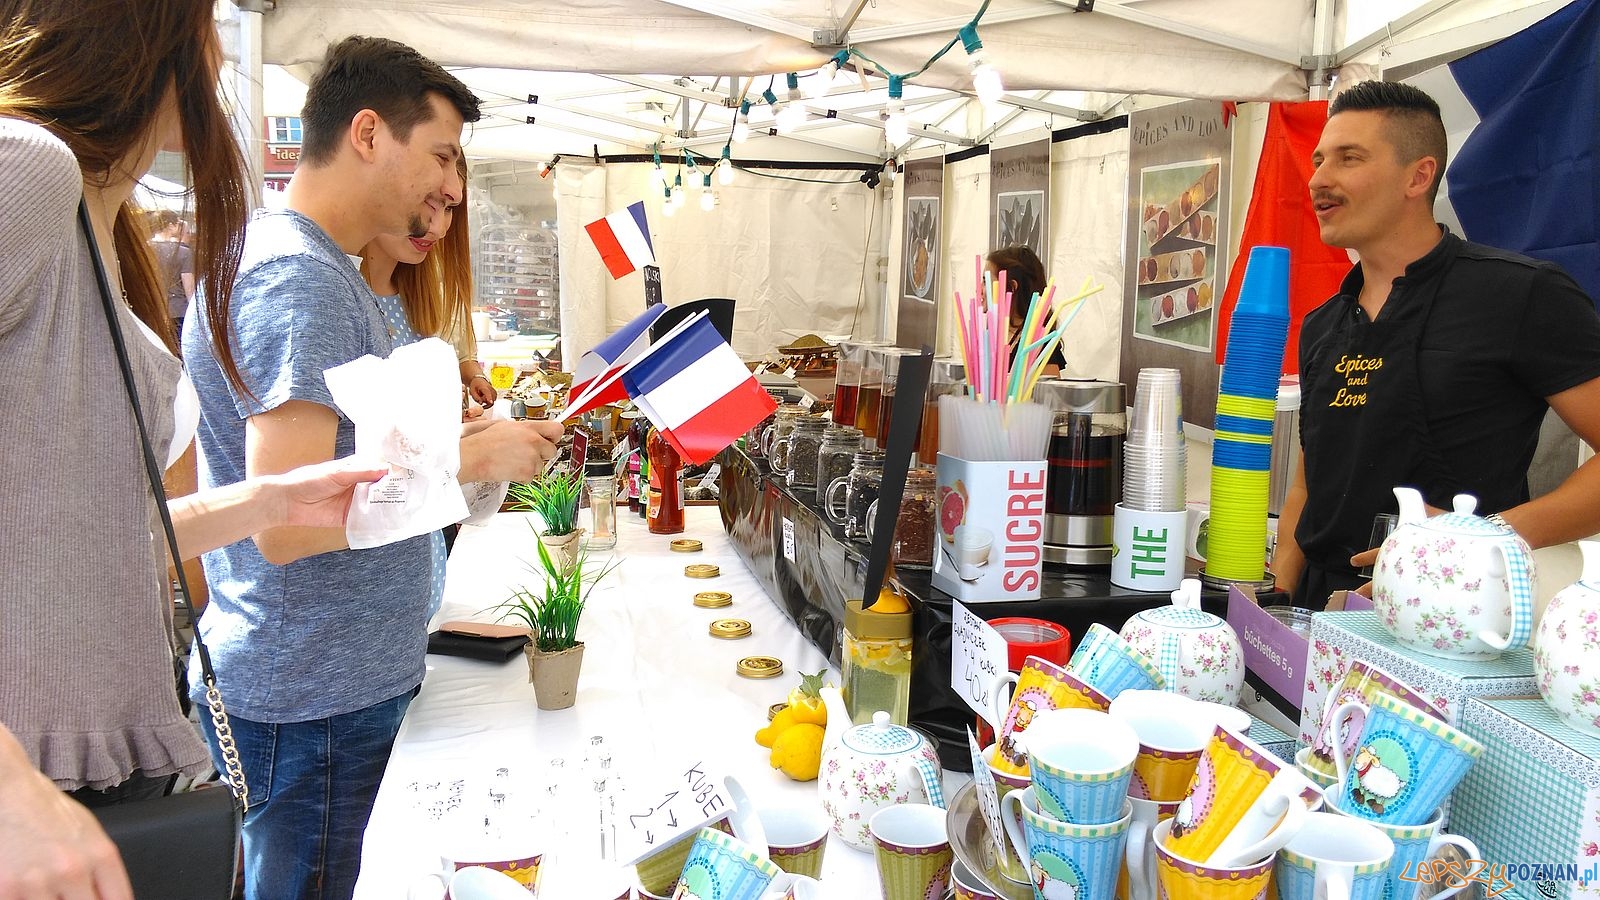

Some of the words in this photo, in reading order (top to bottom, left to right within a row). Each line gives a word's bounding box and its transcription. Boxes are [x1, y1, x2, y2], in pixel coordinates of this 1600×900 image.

[1173, 115, 1195, 132] AND
[1334, 354, 1383, 379] Epices
[1347, 372, 1369, 386] and
[1328, 388, 1367, 407] Love
[1003, 469, 1045, 593] SUCRE
[1130, 526, 1168, 580] THE
[1281, 657, 1288, 671] 5
[1287, 666, 1293, 679] g
[965, 664, 981, 703] 40
